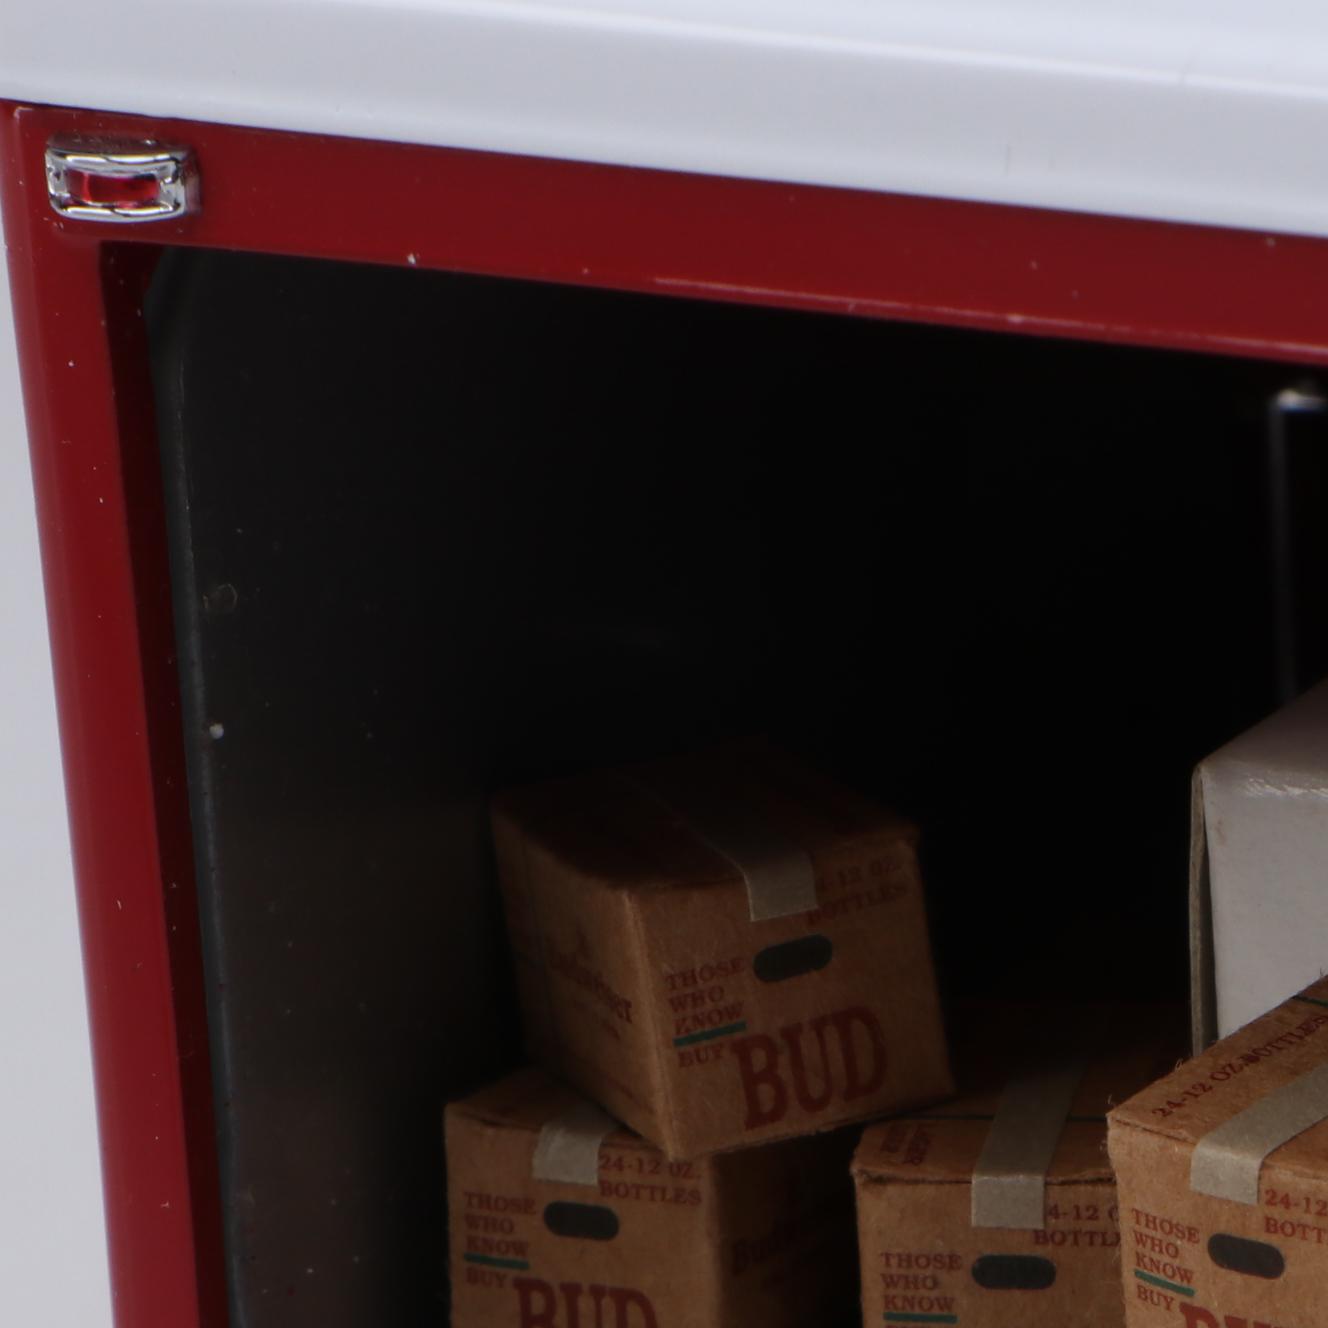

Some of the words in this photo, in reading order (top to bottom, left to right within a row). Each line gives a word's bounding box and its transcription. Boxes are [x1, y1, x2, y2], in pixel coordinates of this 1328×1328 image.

[666, 956, 746, 991] THOSE
[670, 984, 727, 1013] WHO
[674, 1002, 746, 1036] KNOW
[677, 1043, 728, 1069] BUY
[731, 1005, 888, 1131] BUD
[1152, 1082, 1213, 1118] 24-12
[599, 1153, 662, 1177] 24-12
[463, 1191, 537, 1216] THOSE
[599, 1179, 703, 1206] BOTTLES
[465, 1213, 515, 1235] WHO
[1045, 1203, 1101, 1221] 4-12
[1132, 1206, 1201, 1244] THOSE
[465, 1235, 531, 1259] KNOW
[1134, 1230, 1181, 1259] WHO
[880, 1252, 963, 1271] THOSE
[1135, 1252, 1195, 1285] KNOW
[465, 1267, 508, 1290] BUY
[881, 1273, 940, 1291] WHO
[883, 1295, 957, 1314] KNOW
[1136, 1285, 1176, 1312] BUY
